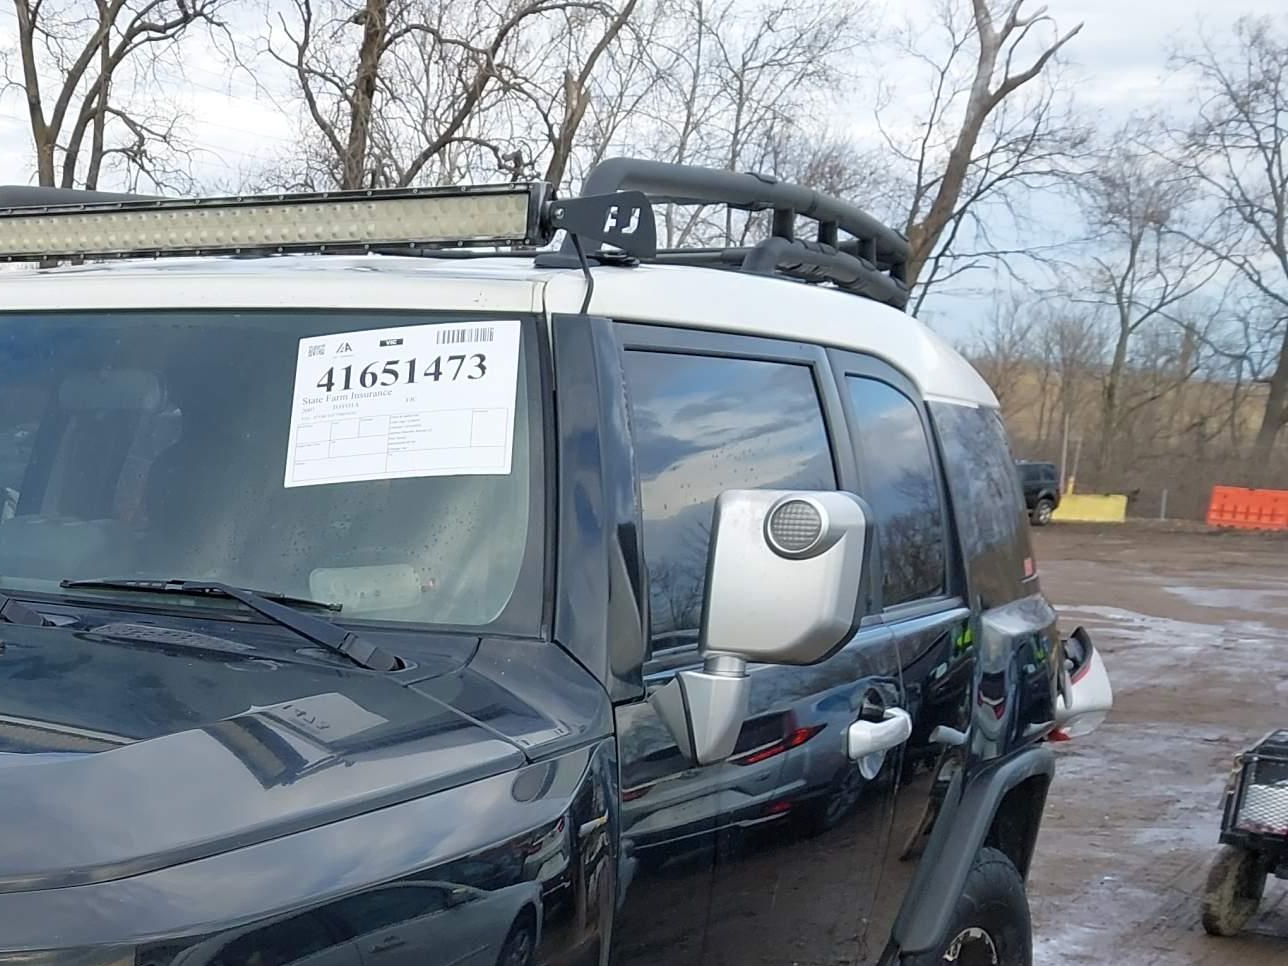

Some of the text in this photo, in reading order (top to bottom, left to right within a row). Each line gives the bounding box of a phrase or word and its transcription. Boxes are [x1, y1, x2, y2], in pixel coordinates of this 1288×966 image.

[603, 206, 641, 234] FJ
[316, 353, 488, 393] 41651473
[301, 389, 393, 406] State Farm Insurance
